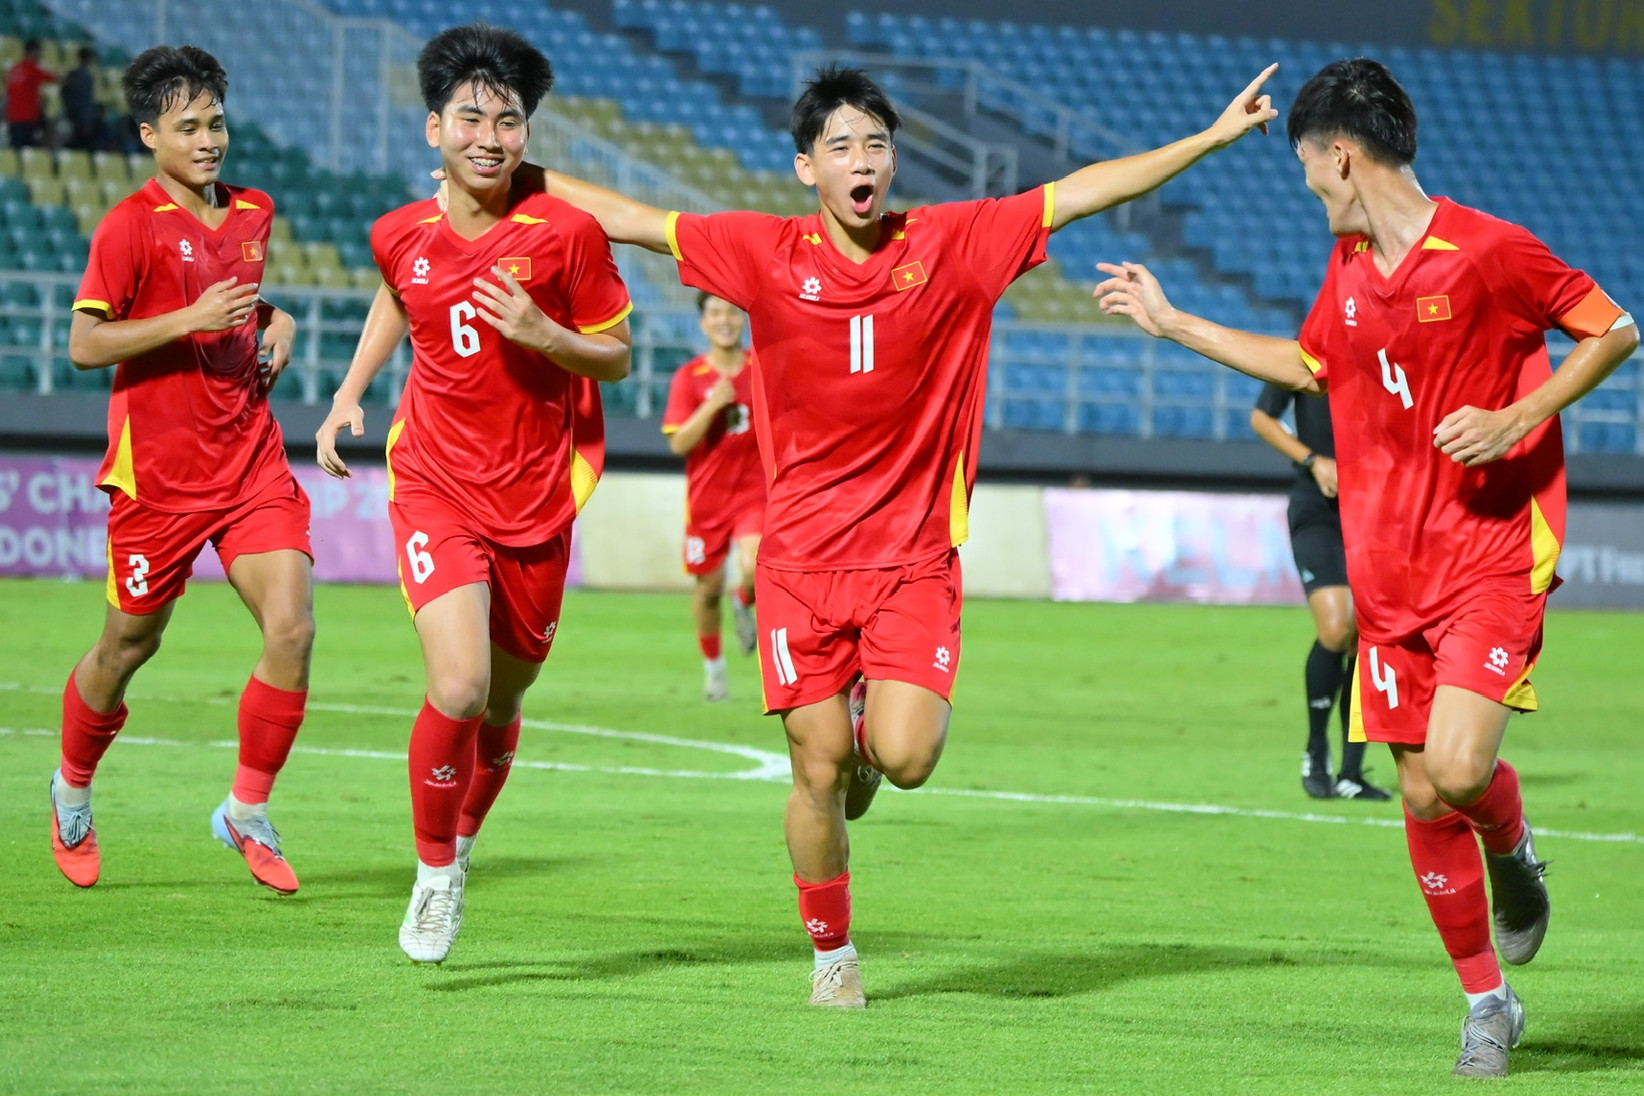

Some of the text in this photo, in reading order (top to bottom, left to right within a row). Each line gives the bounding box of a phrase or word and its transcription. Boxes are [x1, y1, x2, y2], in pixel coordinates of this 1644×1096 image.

[449, 300, 481, 358] 6
[849, 313, 874, 374] 11
[1377, 347, 1414, 410] 4
[126, 553, 150, 598] 3
[406, 530, 436, 585] 6
[770, 627, 798, 686] 11
[1369, 645, 1399, 710] 4
